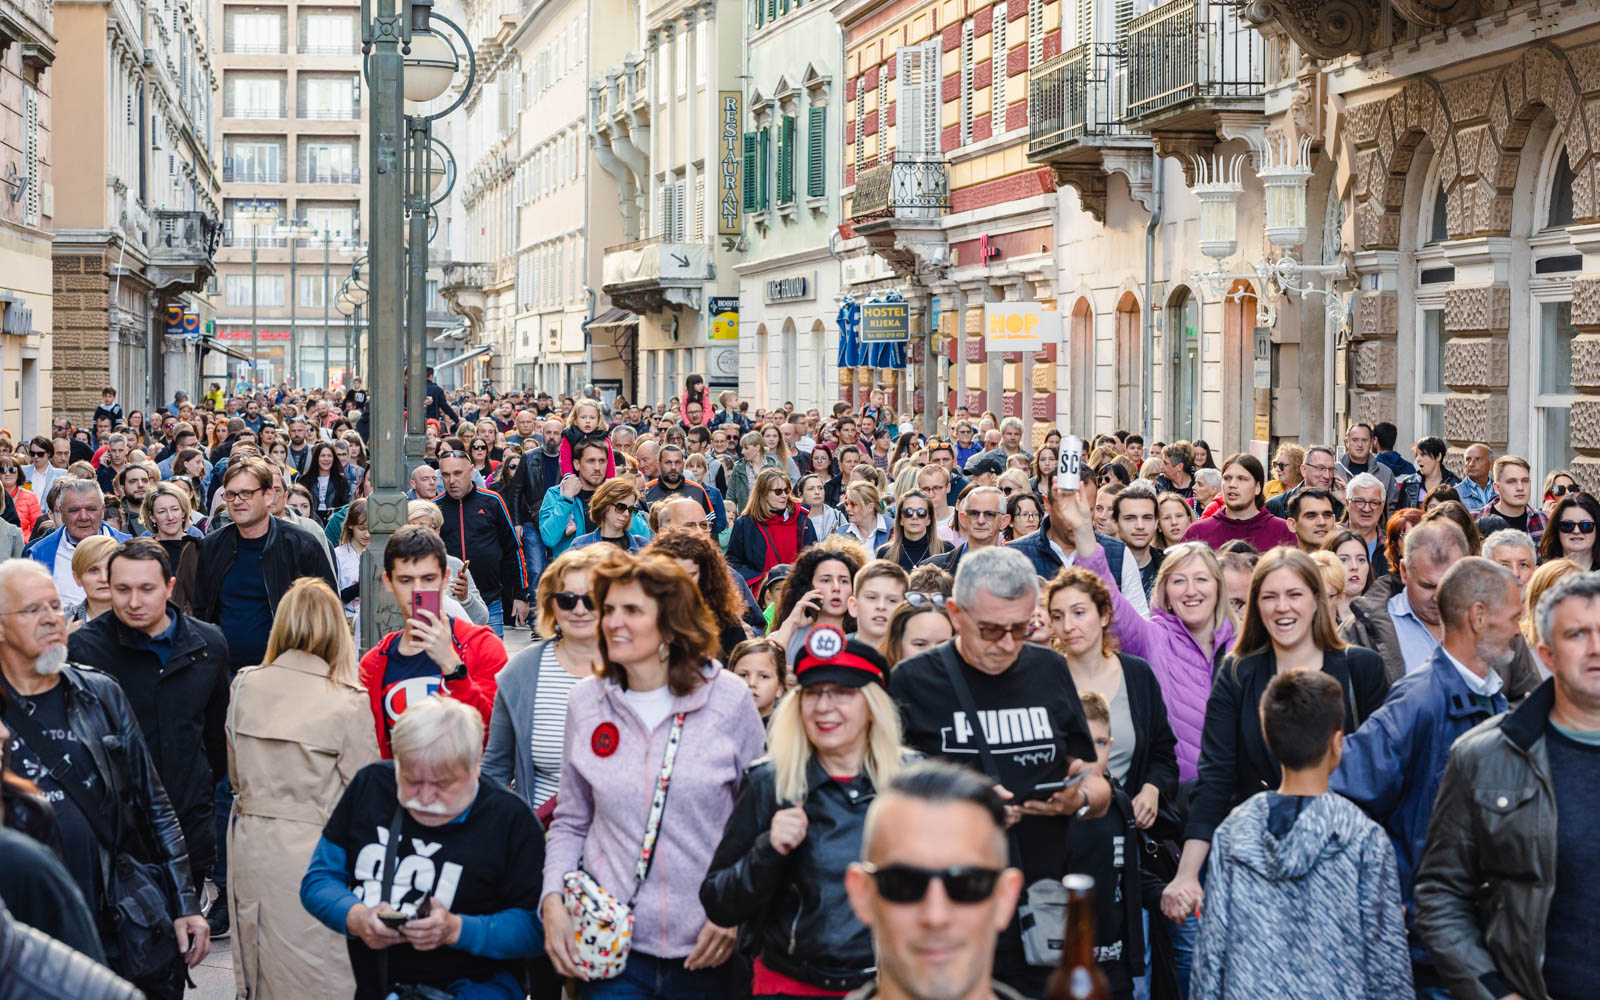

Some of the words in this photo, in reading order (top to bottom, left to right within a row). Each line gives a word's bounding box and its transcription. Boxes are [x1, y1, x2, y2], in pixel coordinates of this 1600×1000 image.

[722, 97, 738, 229] RESTAURANT
[863, 307, 907, 317] HOSTEL
[870, 319, 901, 327] RIJEKA
[989, 313, 1039, 333] HOP
[217, 329, 257, 341] Addik
[260, 329, 291, 341] Bank
[953, 706, 1054, 744] PUMA
[49, 729, 65, 740] TO
